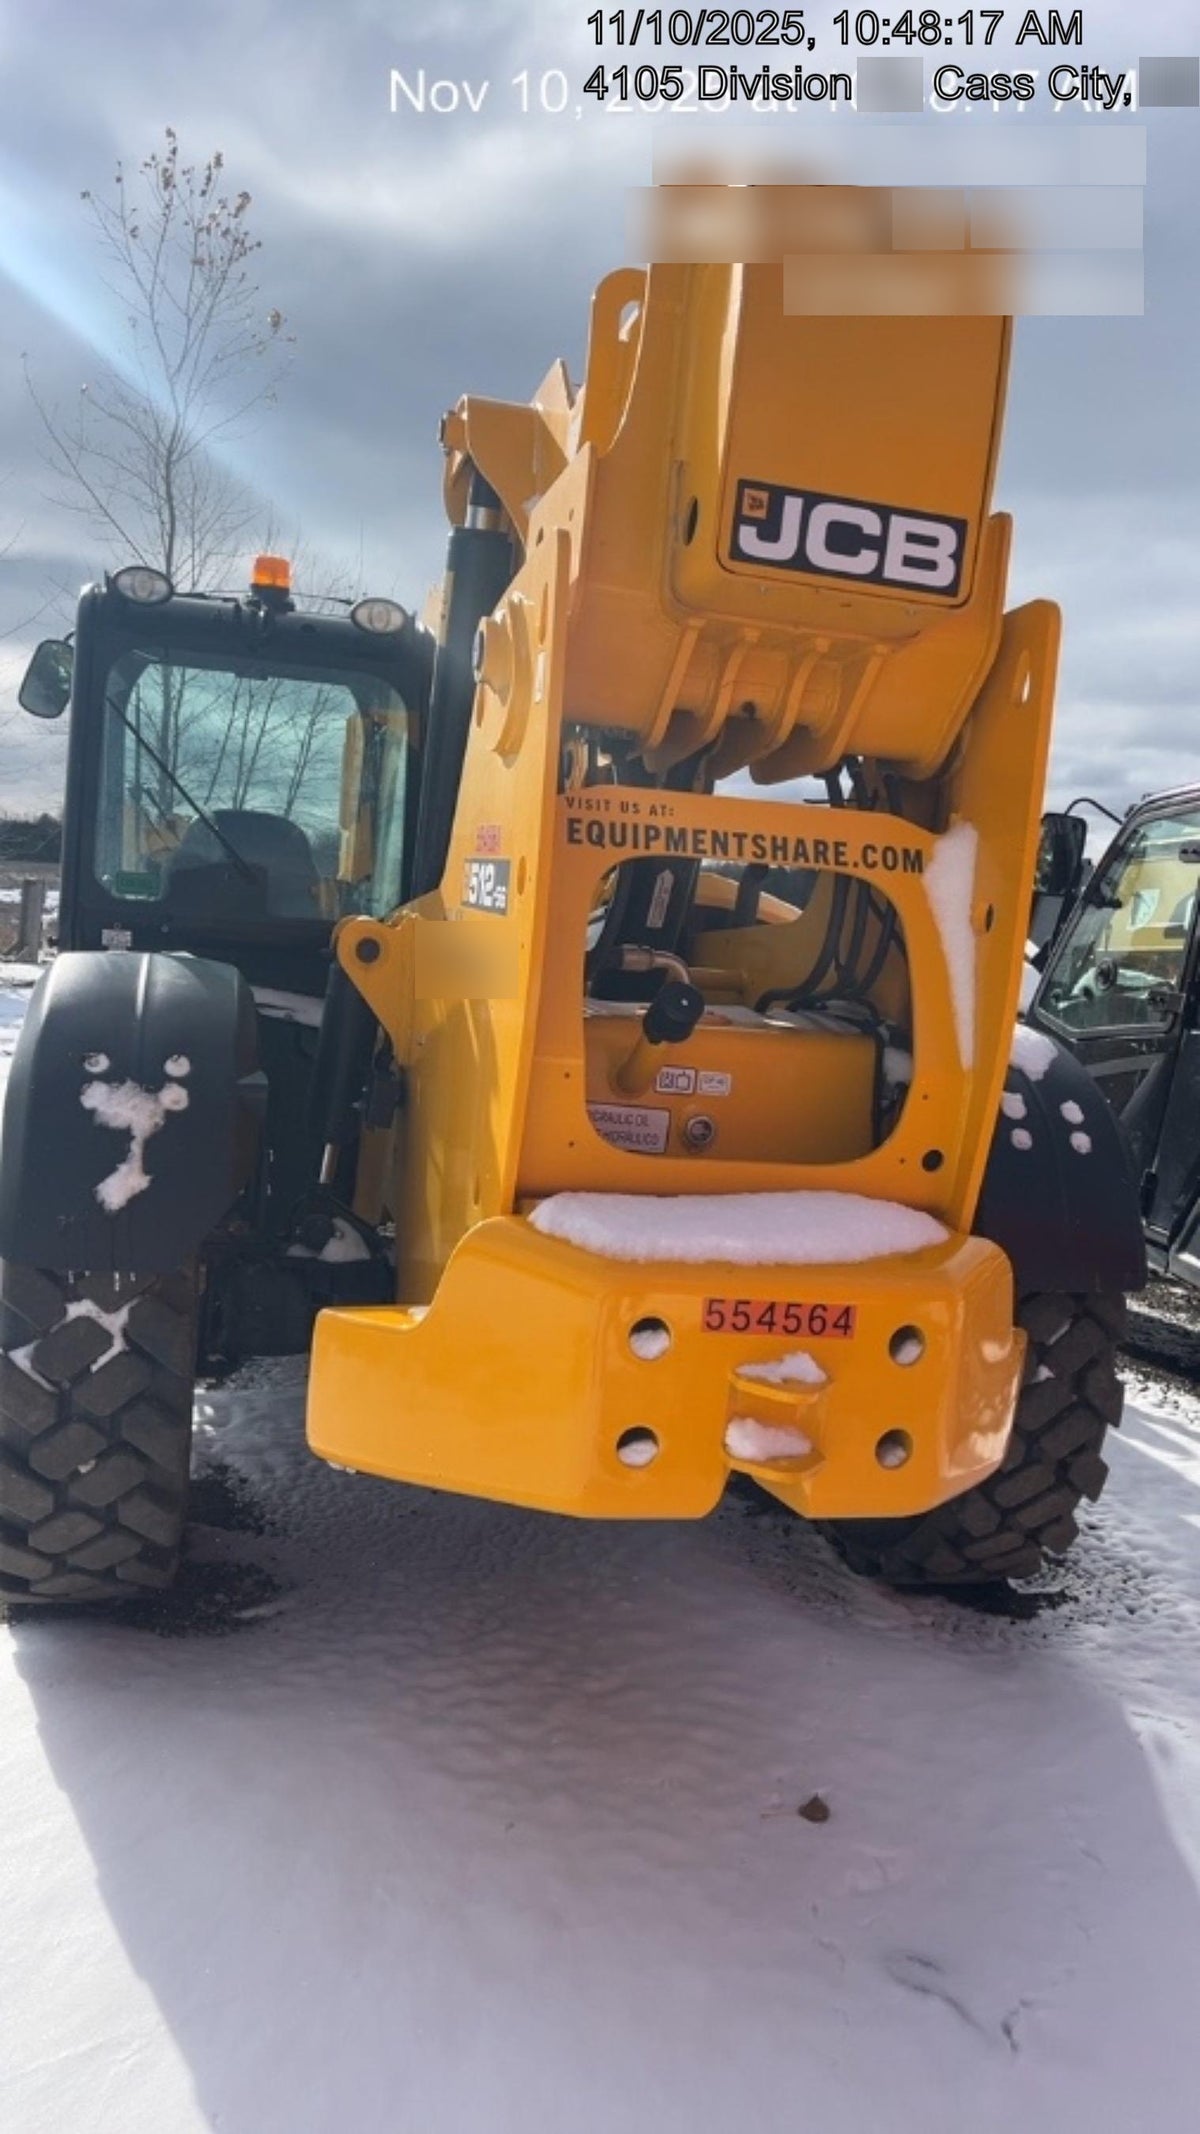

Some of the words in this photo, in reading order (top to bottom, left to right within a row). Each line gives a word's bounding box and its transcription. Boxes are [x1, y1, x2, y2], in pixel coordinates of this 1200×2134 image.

[738, 494, 958, 587] JCB
[565, 796, 611, 812] VISIT
[620, 800, 641, 815] US
[649, 803, 675, 817] AT:
[566, 817, 925, 874] EQUIPMENTSHARE.COM
[706, 1298, 852, 1336] 554564
